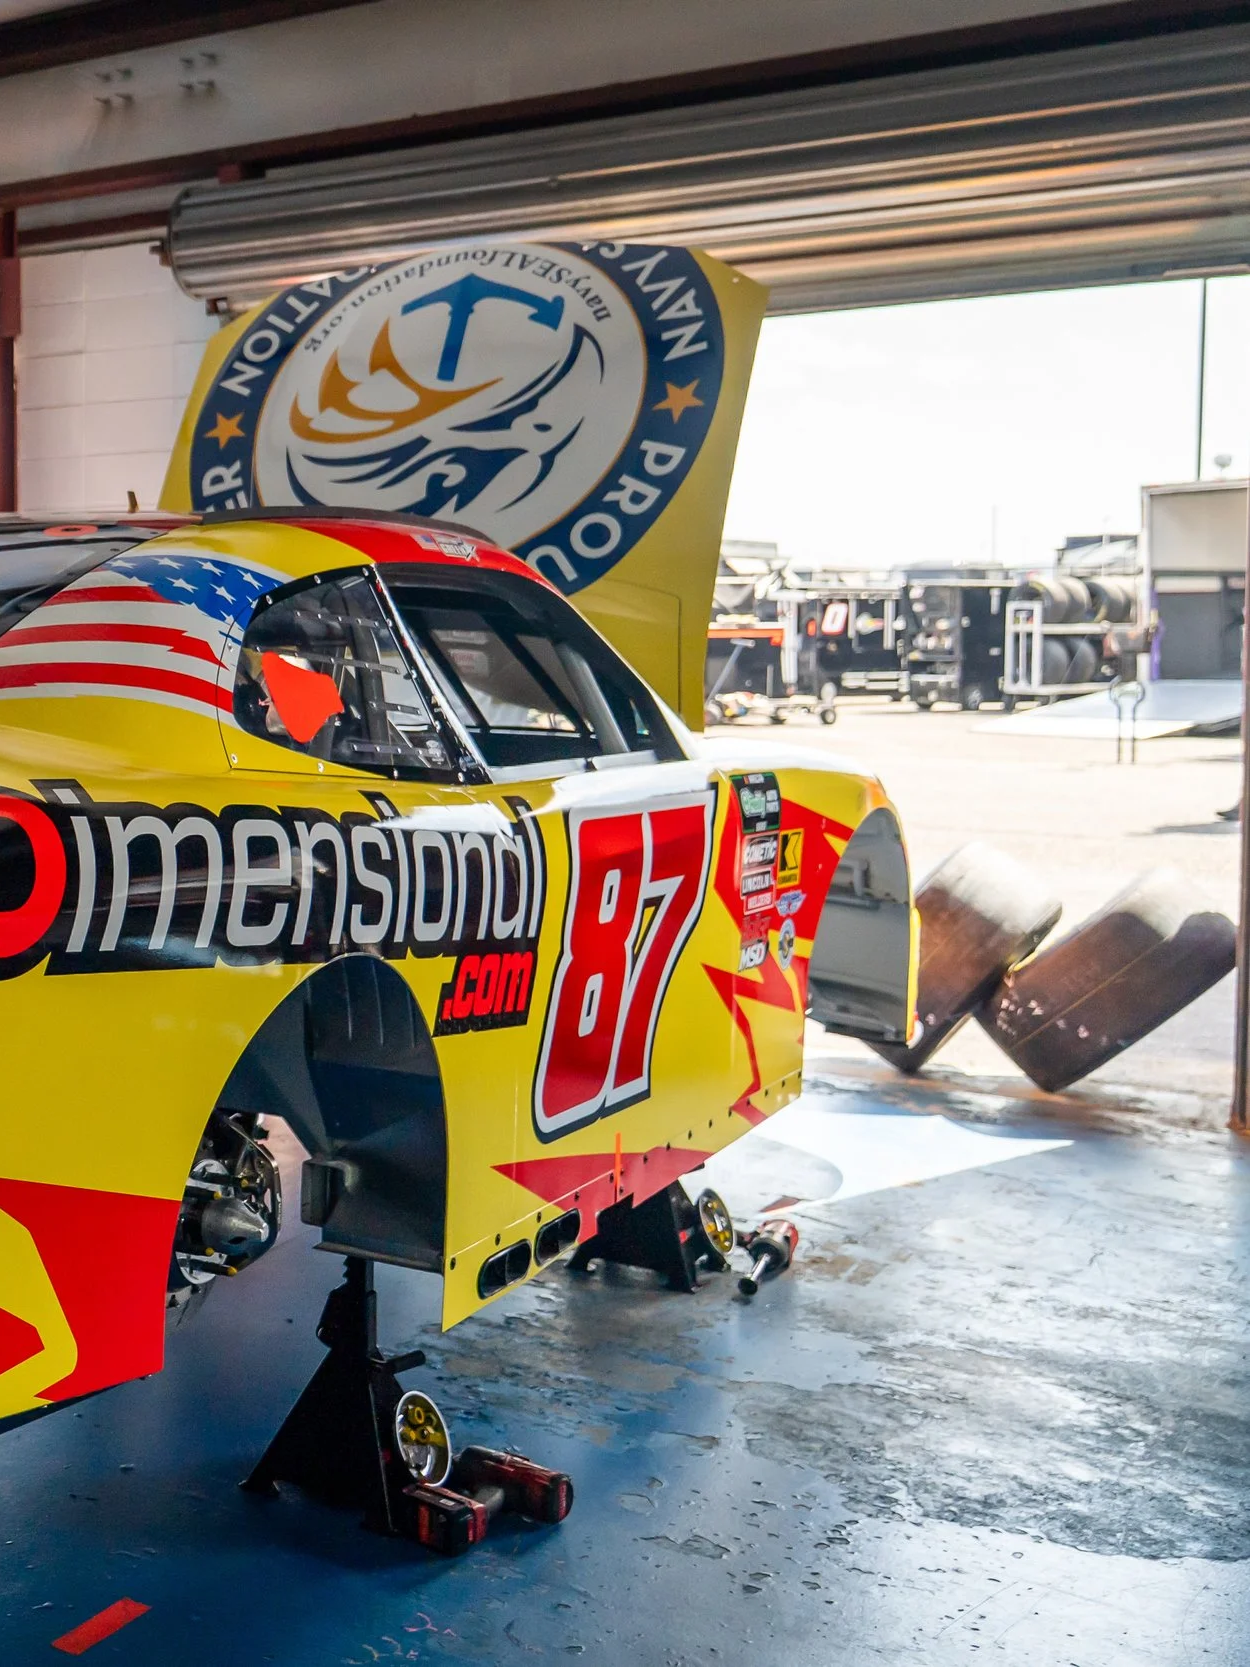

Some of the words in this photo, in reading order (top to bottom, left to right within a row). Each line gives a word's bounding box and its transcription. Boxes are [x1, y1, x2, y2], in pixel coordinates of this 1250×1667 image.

[620, 249, 708, 363] NAVY
[441, 950, 534, 1021] .com
[536, 796, 714, 1131] 87
[738, 941, 767, 972] MSD
